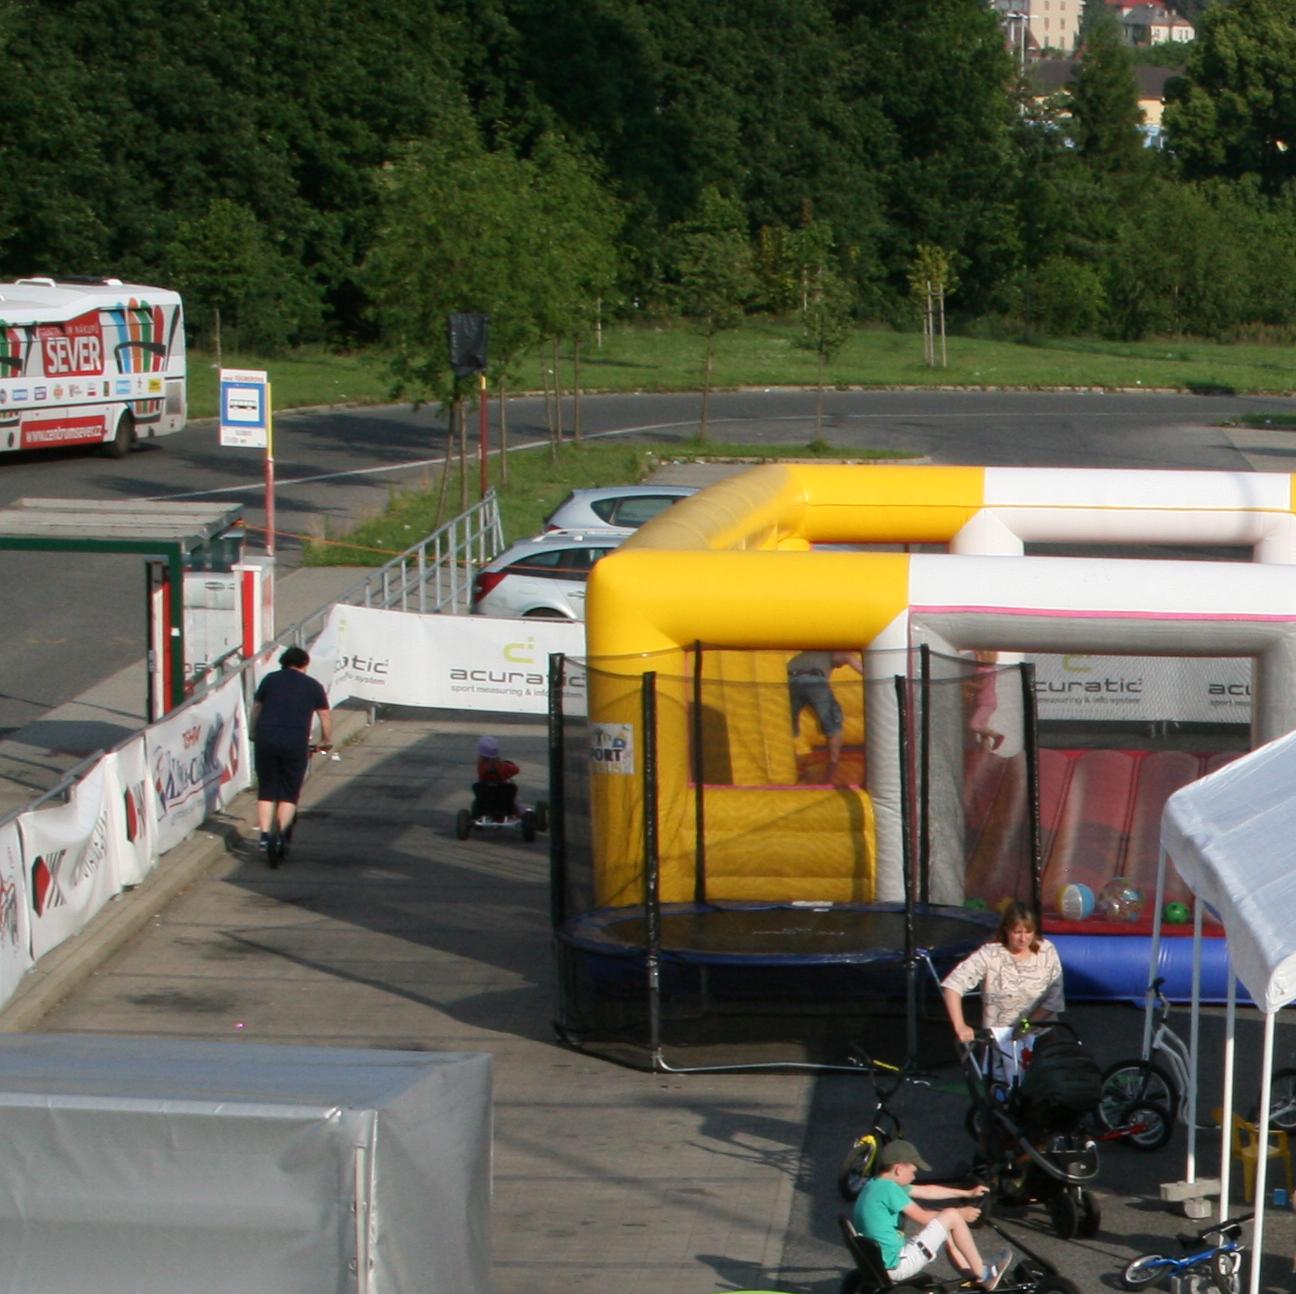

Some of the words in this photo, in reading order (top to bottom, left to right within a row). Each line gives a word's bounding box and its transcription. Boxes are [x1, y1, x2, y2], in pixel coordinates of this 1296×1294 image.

[47, 336, 101, 374] SEVER
[450, 668, 588, 688] acurac
[1033, 678, 1143, 694] curatic
